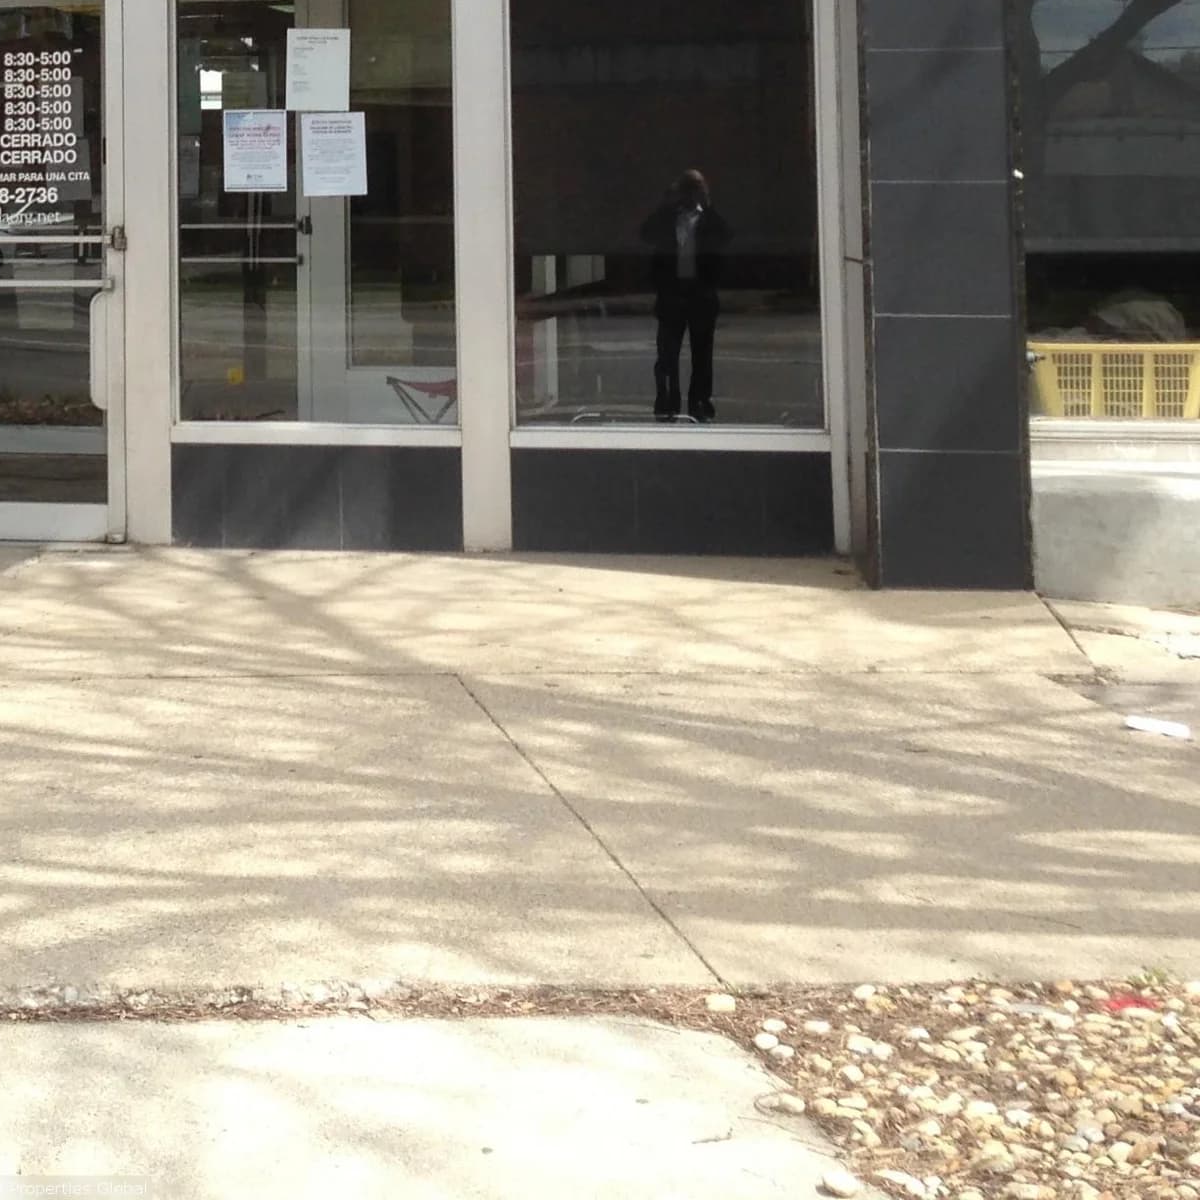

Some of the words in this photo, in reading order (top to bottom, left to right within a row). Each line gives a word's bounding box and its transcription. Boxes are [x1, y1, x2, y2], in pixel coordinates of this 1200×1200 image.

[4, 52, 71, 65] 8:30-5:00
[4, 68, 71, 82] 8:30-5:00
[4, 84, 72, 98] 8:30-5:00
[4, 101, 72, 115] 8:30-5:00
[4, 117, 72, 131] 8:30-5:00
[0, 134, 77, 148] CERRADO
[0, 150, 77, 164] CERRADO
[19, 172, 43, 182] PARA
[46, 172, 66, 181] UNA
[68, 171, 90, 181] CITA
